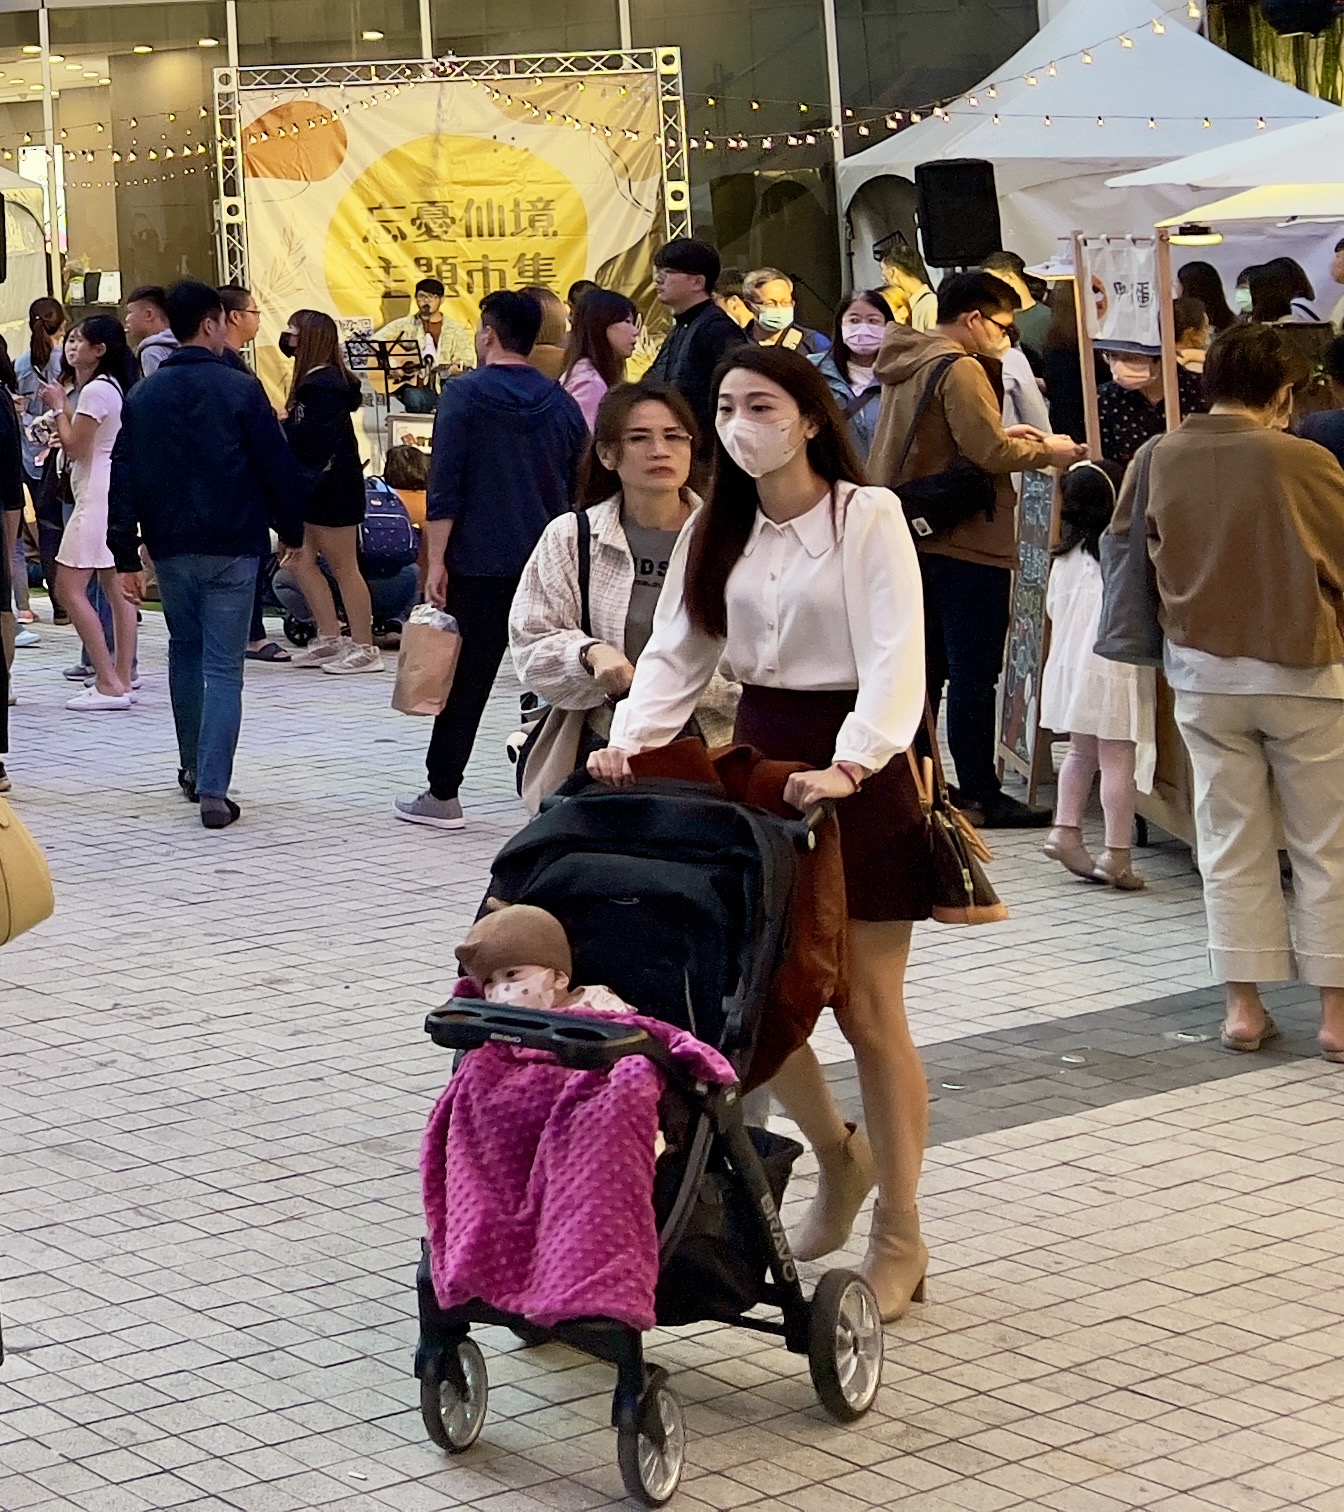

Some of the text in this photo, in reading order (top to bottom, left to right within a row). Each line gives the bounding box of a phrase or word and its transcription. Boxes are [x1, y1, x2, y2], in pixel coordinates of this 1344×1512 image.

[361, 196, 559, 244] 忘憂仙境
[363, 252, 560, 300] 主題市集
[760, 1192, 796, 1283] BRAVO
